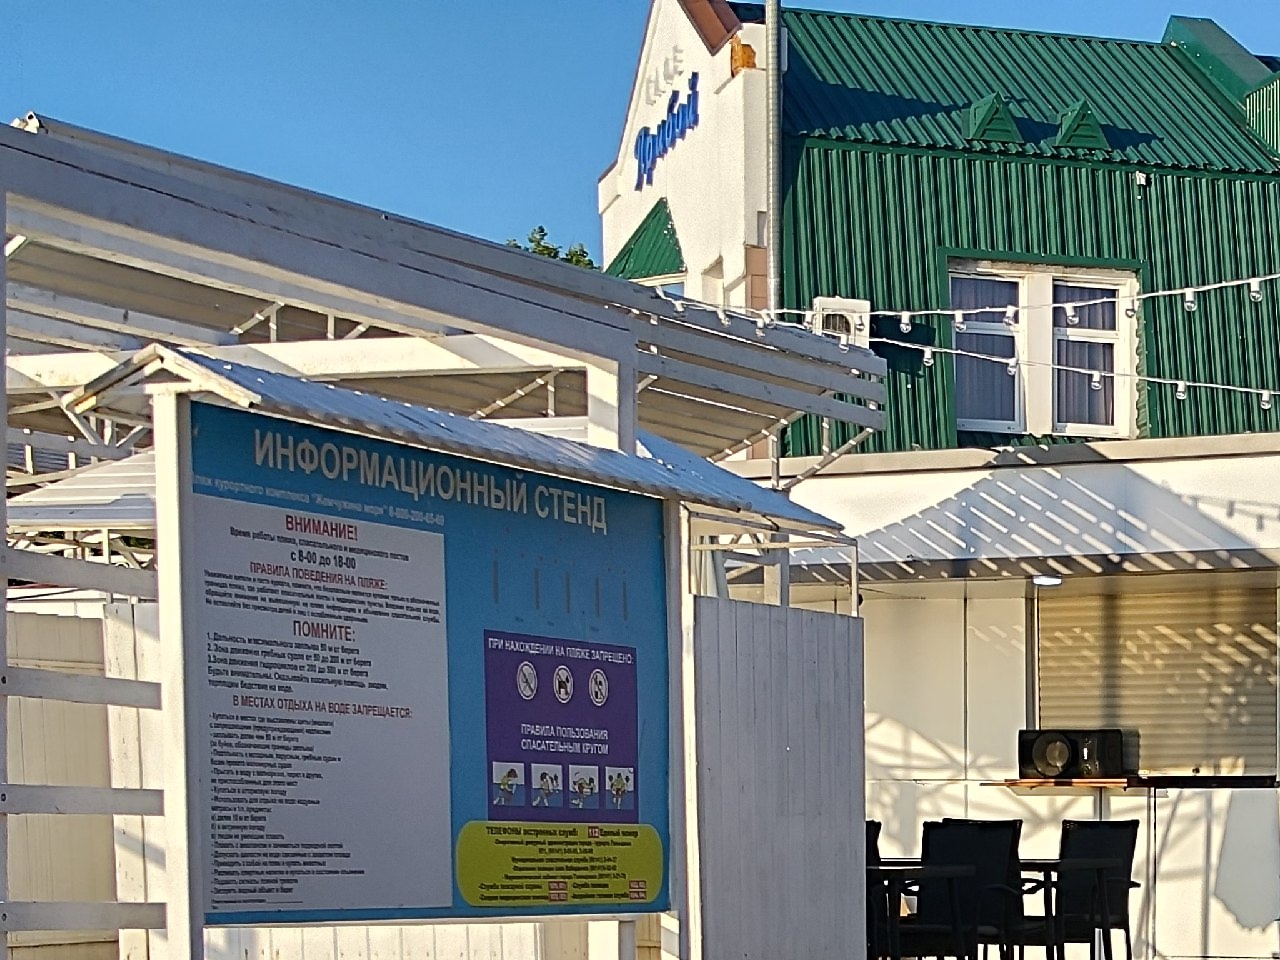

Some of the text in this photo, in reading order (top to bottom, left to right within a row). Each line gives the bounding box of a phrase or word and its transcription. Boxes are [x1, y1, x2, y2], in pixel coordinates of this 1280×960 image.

[254, 429, 607, 535] ИНФОРМАЦИОННЫЙ СТЕНД
[285, 513, 357, 540] ВНИМАНИЕ!
[290, 549, 356, 569] с 8-00 до 18-00
[250, 561, 289, 578] ПРАВИЛА
[292, 566, 342, 585] ПОВЕДЕНИЯ
[344, 573, 355, 586] НА
[292, 619, 355, 642] ПОМНИТЕ:
[488, 638, 503, 649] ПРИ
[505, 640, 554, 655] НАХОЖДЕНИИ
[555, 645, 565, 655] НА
[233, 694, 412, 719] В МЕСТАХ ОТДЫХА НА ВОДЕ ЗАПРЕЩАЕТСЯ:
[521, 724, 609, 739] ПРАВИЛА ПОЛЬЗОВАНИЯ
[521, 739, 609, 755] СПАСАТЕЛЬНЫМ КРУГОМ
